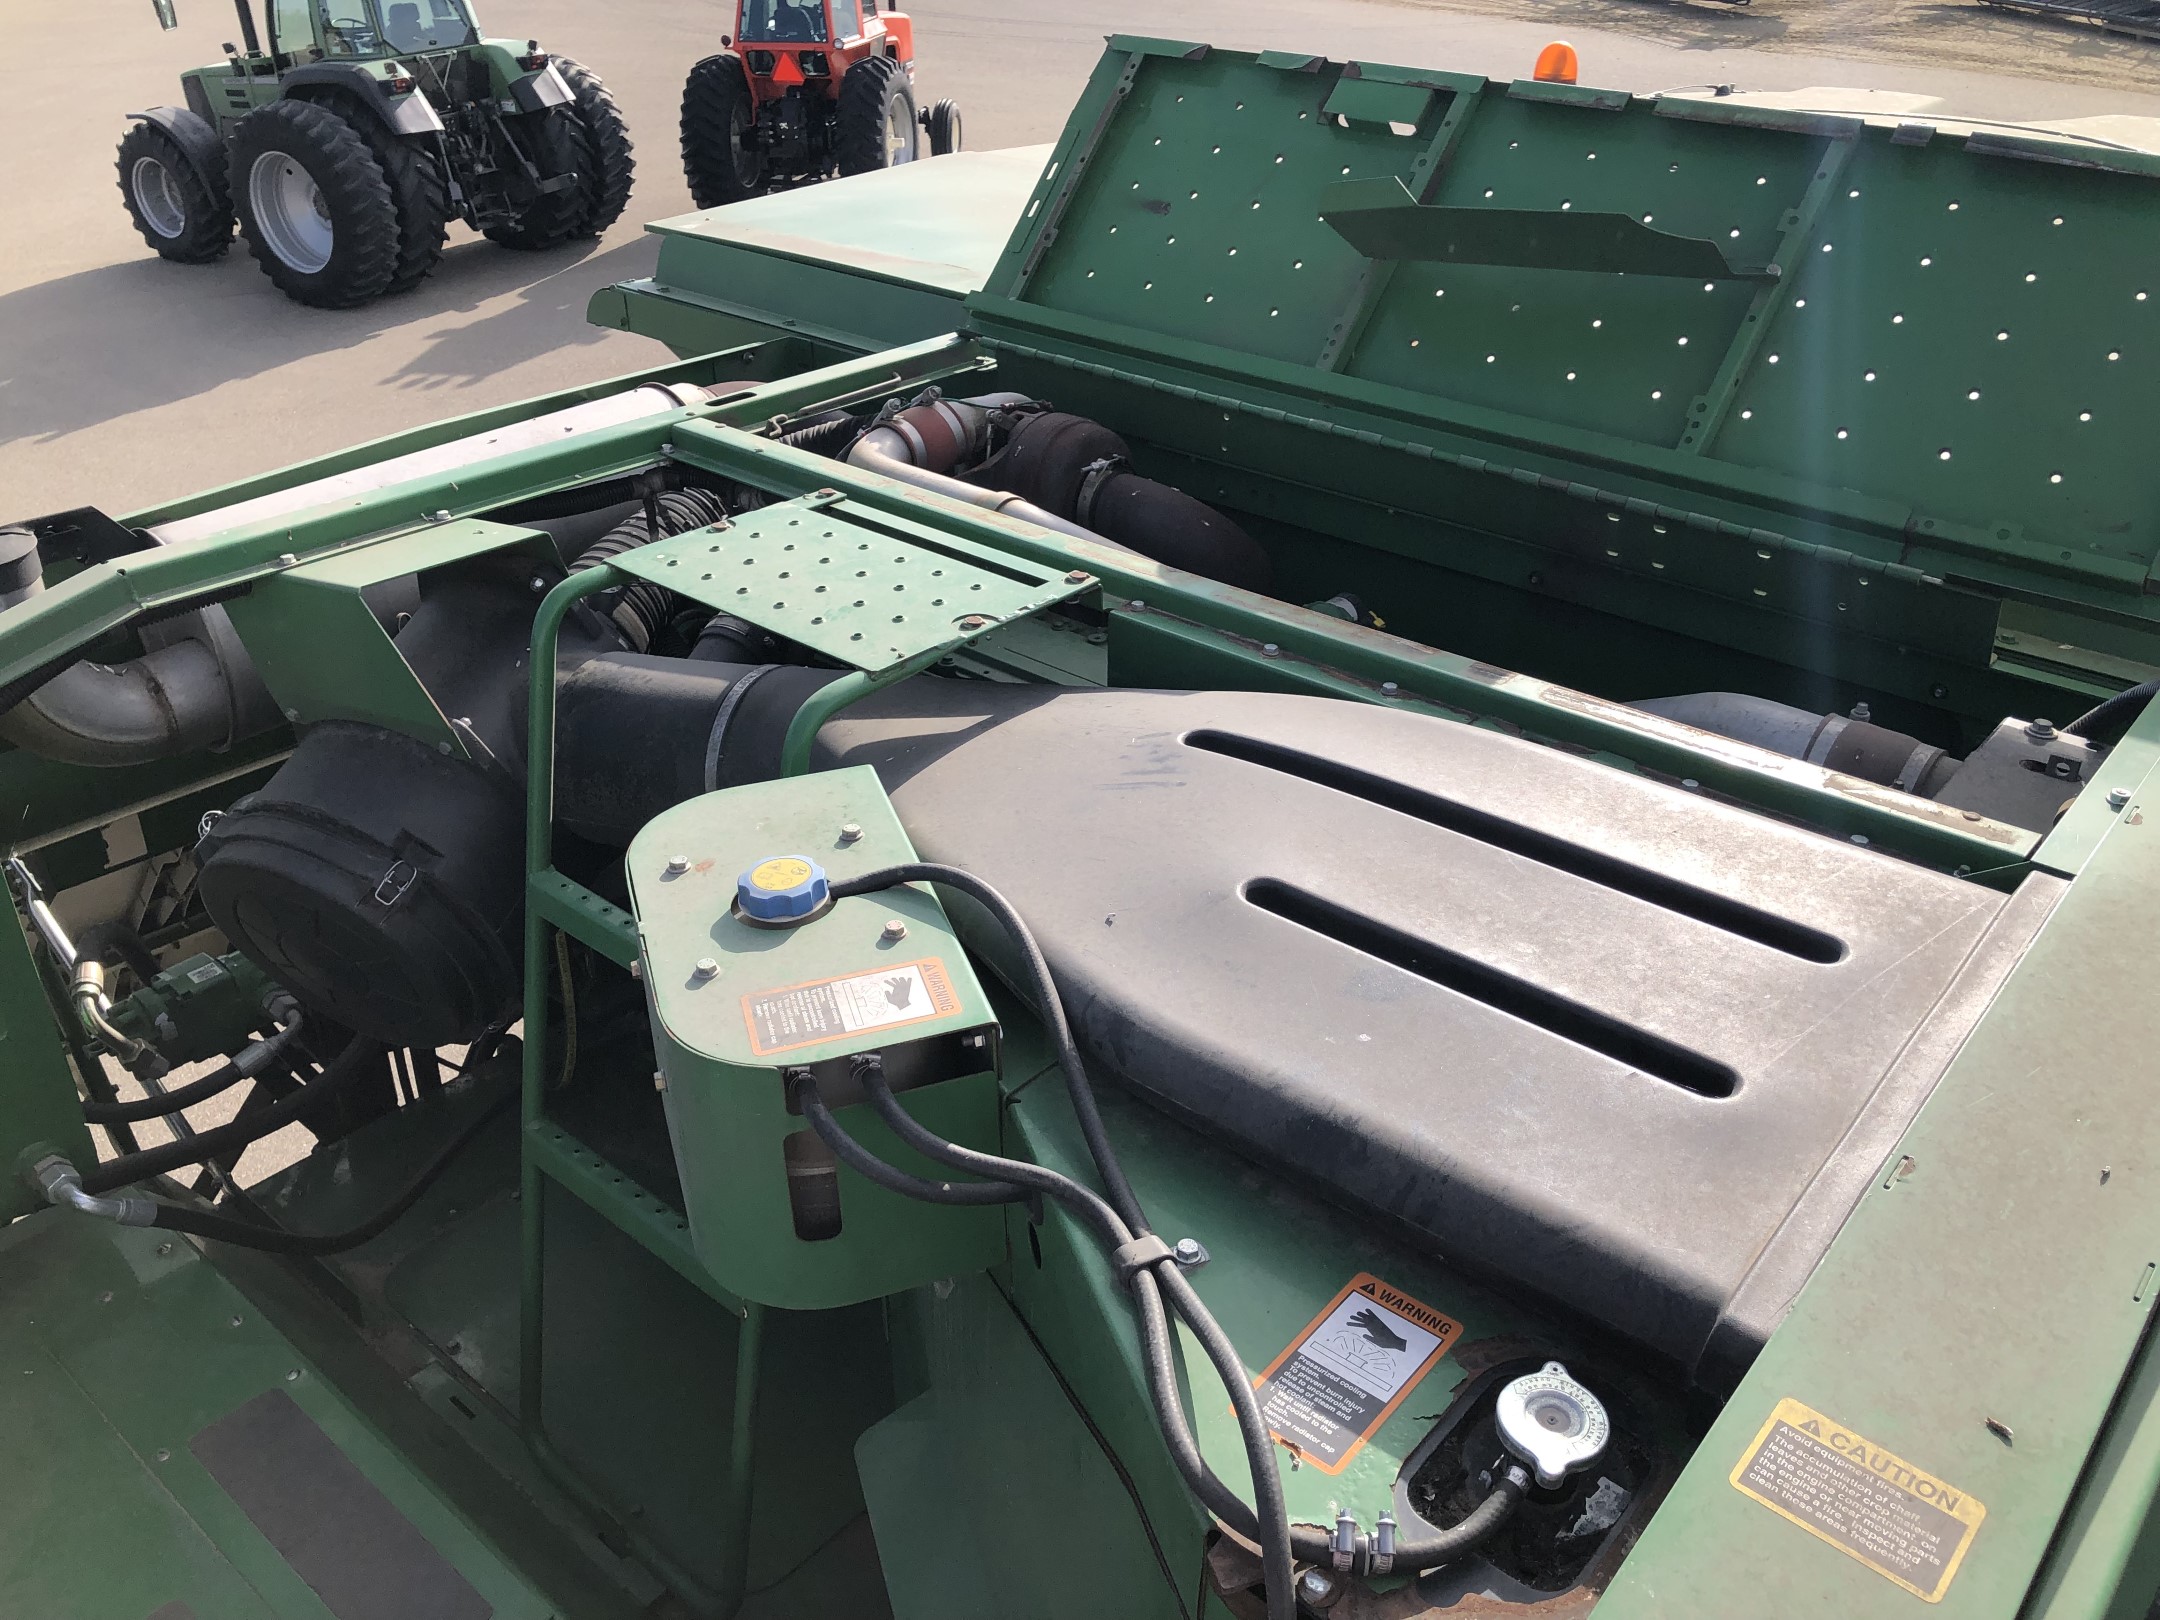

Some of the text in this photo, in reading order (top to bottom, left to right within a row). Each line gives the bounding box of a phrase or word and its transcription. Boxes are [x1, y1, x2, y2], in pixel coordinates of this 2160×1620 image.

[926, 971, 954, 1011] WARNING
[1379, 1288, 1451, 1335] WARNING
[1283, 1370, 1352, 1413] due to uncontrolled
[1289, 1365, 1365, 1413] To prevent burn injury
[1292, 1360, 1319, 1379] system.
[1297, 1354, 1367, 1399] Pressurized cooling
[1266, 1400, 1288, 1417] touch.
[1271, 1395, 1285, 1406] has
[1285, 1404, 1311, 1421] cooled
[1319, 1424, 1332, 1434] the
[1273, 1380, 1314, 1408] hot coolant:
[1277, 1390, 1293, 1403] Wait
[1293, 1400, 1311, 1413] until
[1309, 1411, 1339, 1430] radiator
[1278, 1375, 1304, 1393] release
[1313, 1397, 1335, 1412] steam
[1335, 1410, 1351, 1421] and
[1262, 1405, 1335, 1452] Remove radiator cap
[1774, 1434, 1794, 1450] The
[1795, 1449, 1872, 1495] accumulation
[1874, 1494, 1888, 1503] of
[1779, 1426, 1904, 1500] Avoid equipment fires.
[1829, 1432, 1959, 1512] CAUTION
[1753, 1465, 1774, 1480] can
[1776, 1478, 1810, 1500] cause
[1822, 1503, 1844, 1521] fire.
[1851, 1519, 1895, 1550] Inspect
[1896, 1548, 1920, 1564] and
[1758, 1456, 1940, 1565] the engine or near moving parts
[1763, 1449, 1774, 1459] in
[1776, 1456, 1794, 1471] the
[1796, 1469, 1835, 1494] engine
[1920, 1540, 1936, 1553] on
[1768, 1441, 1940, 1544] leaves and other crop material
[1749, 1472, 1778, 1492] clean
[1814, 1511, 1847, 1532] areas
[1850, 1530, 1911, 1571] frequently.
